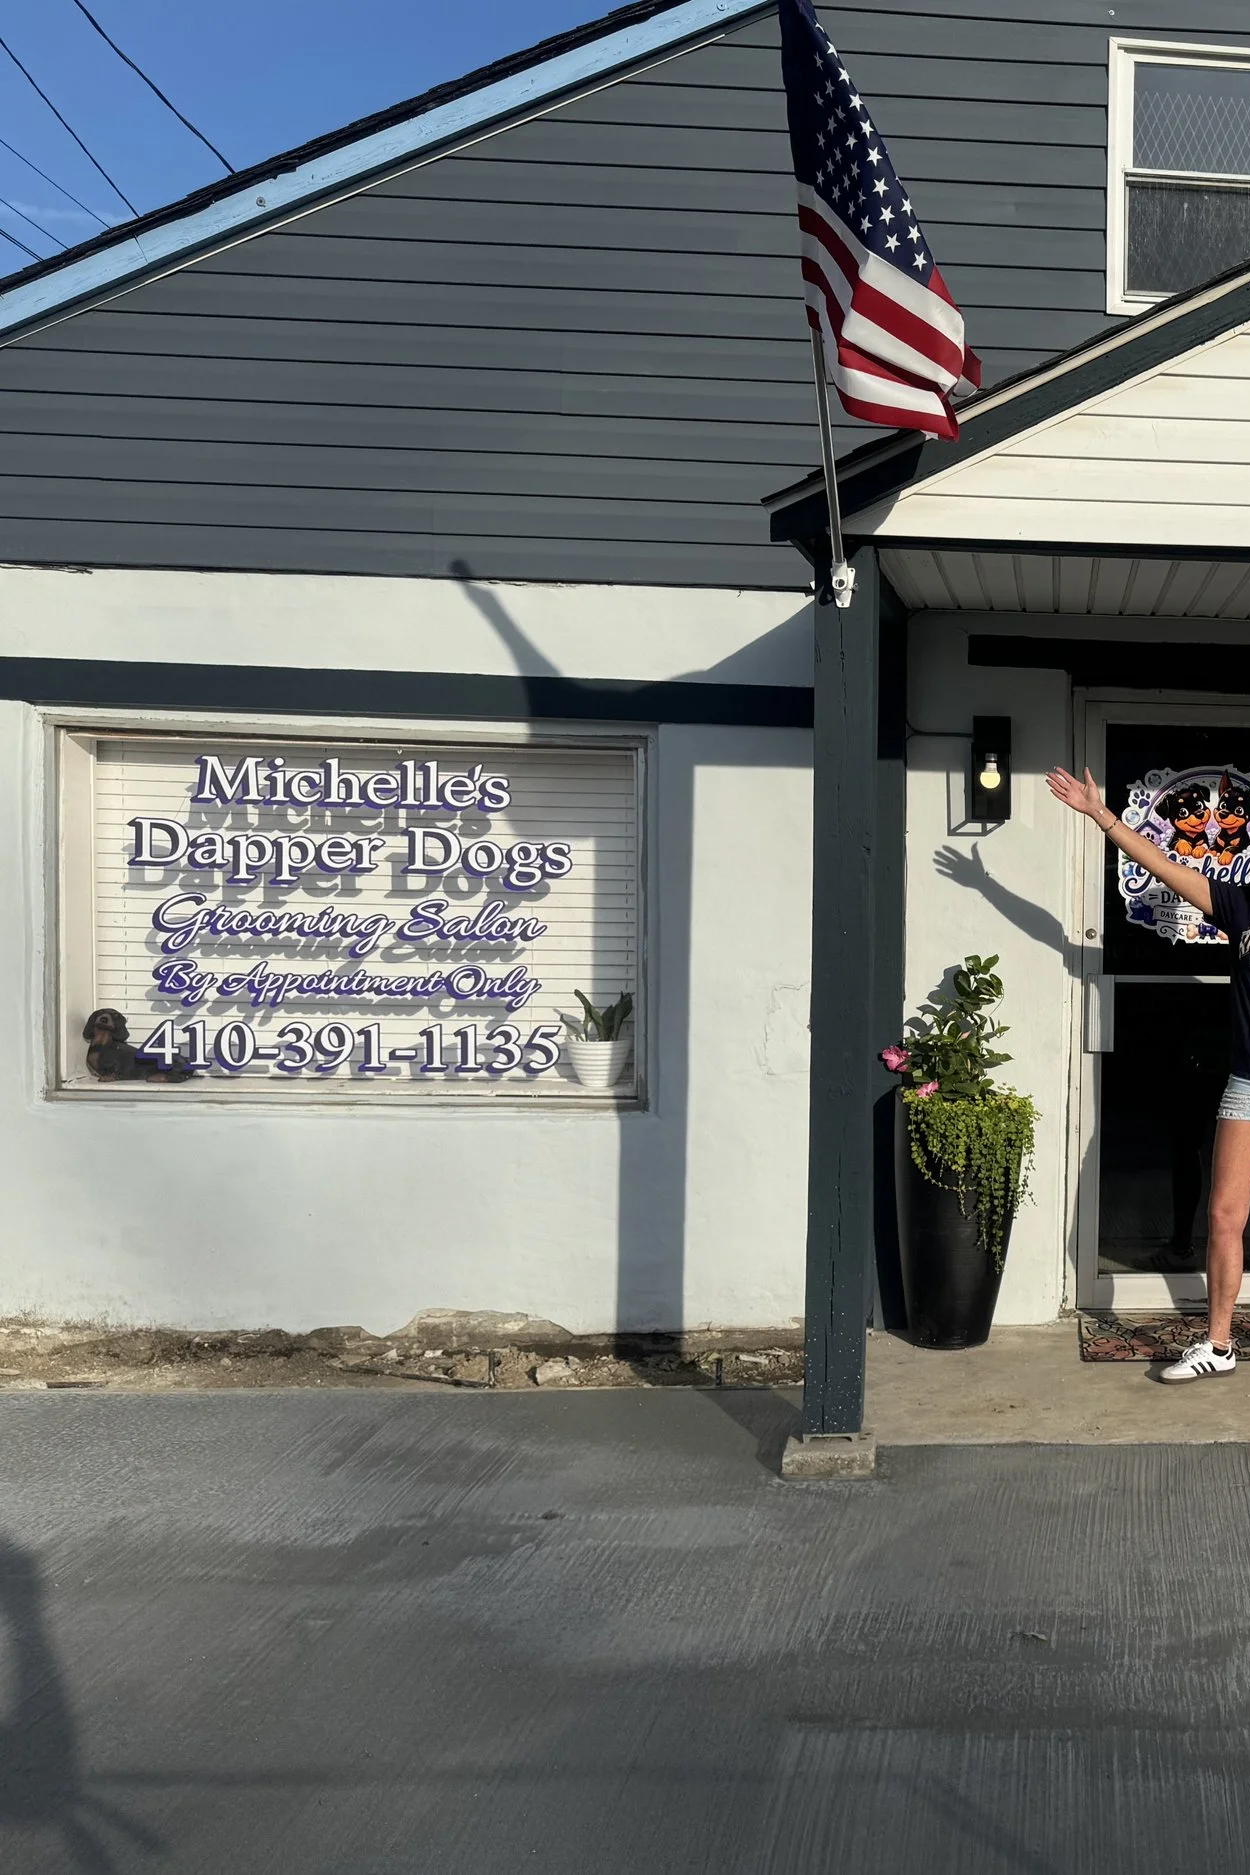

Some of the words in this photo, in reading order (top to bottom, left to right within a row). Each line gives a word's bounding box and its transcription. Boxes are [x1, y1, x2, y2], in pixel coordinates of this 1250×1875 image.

[191, 754, 511, 810] Michelle's
[127, 817, 385, 884] Dapper
[400, 827, 574, 890] Dogs
[152, 892, 396, 959] Grooming
[397, 899, 547, 942] Salon
[1160, 910, 1193, 921] DAYCARE
[155, 960, 218, 1006] By
[217, 961, 446, 1008] Appointment
[445, 965, 541, 1011] Only
[135, 1020, 562, 1075] 410-391-1135
